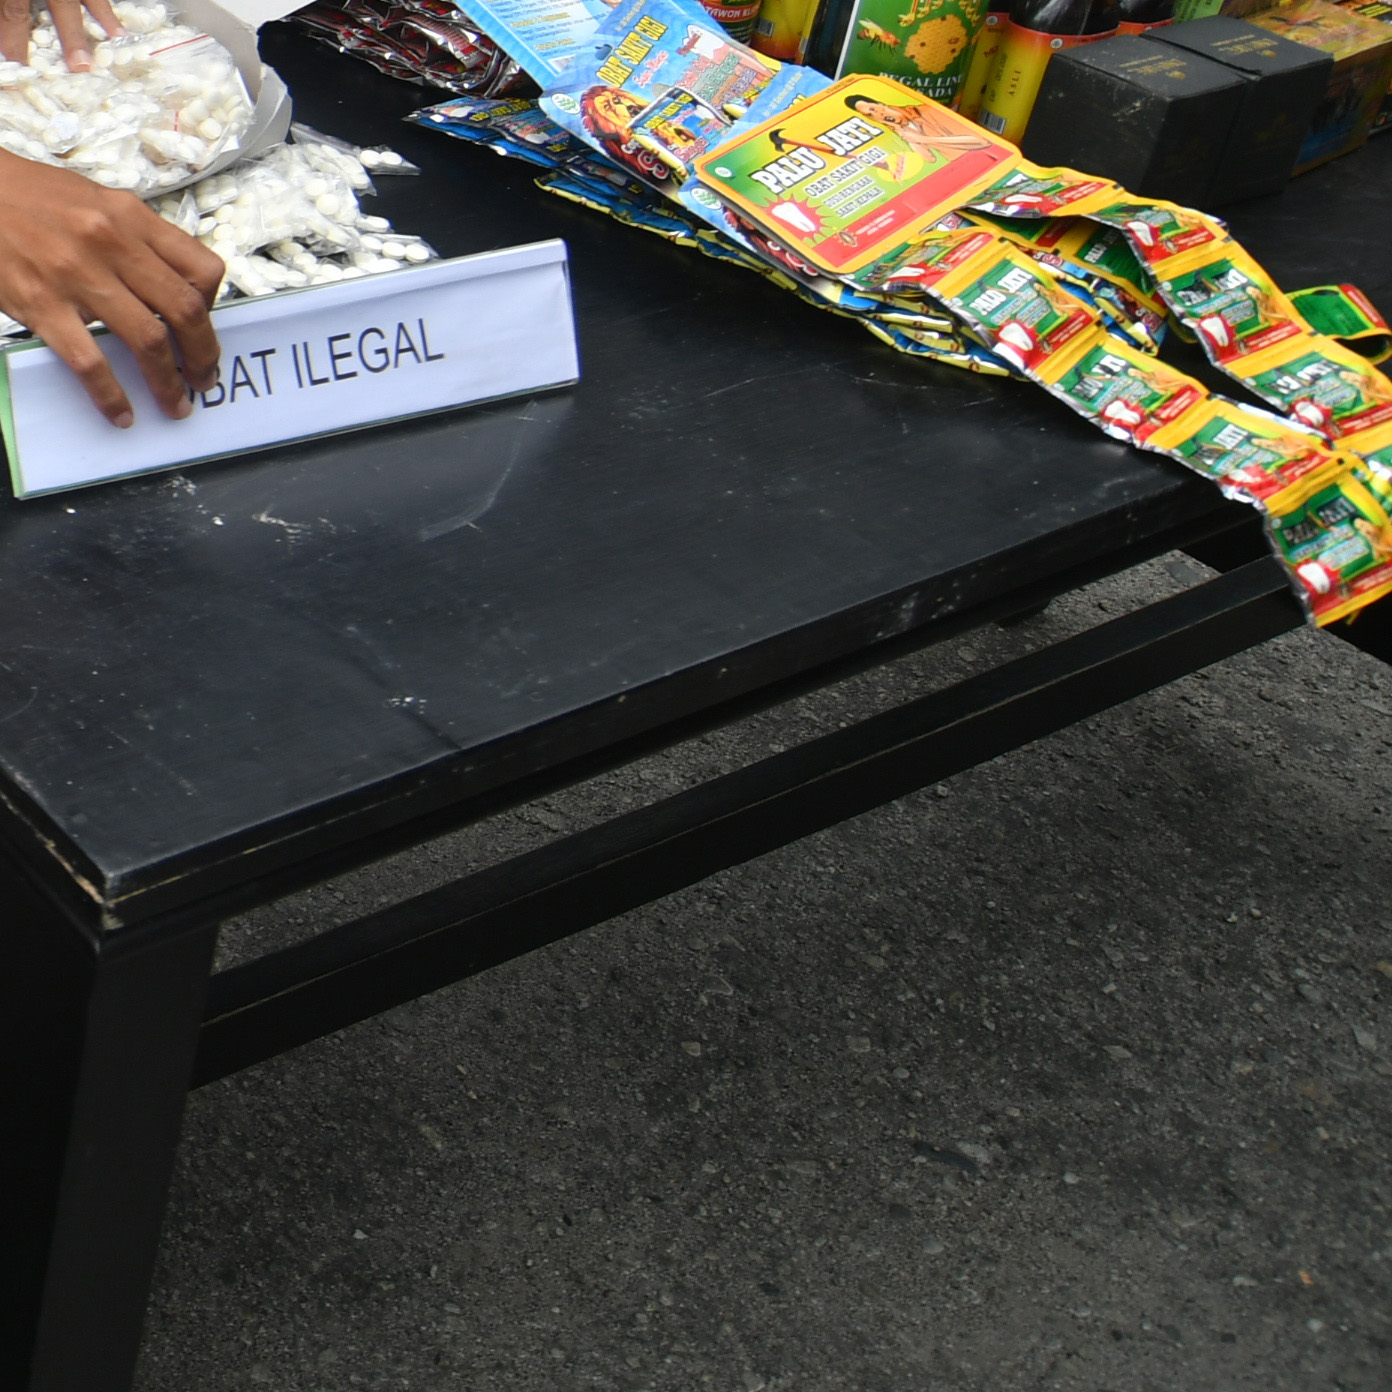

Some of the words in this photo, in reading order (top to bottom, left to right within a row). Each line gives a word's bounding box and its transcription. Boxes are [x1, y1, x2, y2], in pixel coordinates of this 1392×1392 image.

[633, 14, 669, 41] GIGI
[614, 31, 654, 66] SAKIT
[596, 54, 634, 88] OBAT
[1008, 70, 1022, 97] ASLI
[747, 147, 828, 195] PALU
[817, 115, 886, 157] JATI
[804, 176, 835, 198] OBAT
[834, 157, 862, 182] SAKIT
[862, 146, 887, 167] GIGI
[835, 201, 858, 218] SAKIT
[856, 187, 884, 207] KEPALA
[179, 348, 276, 409] BAT
[290, 317, 446, 390] ILEGAL
